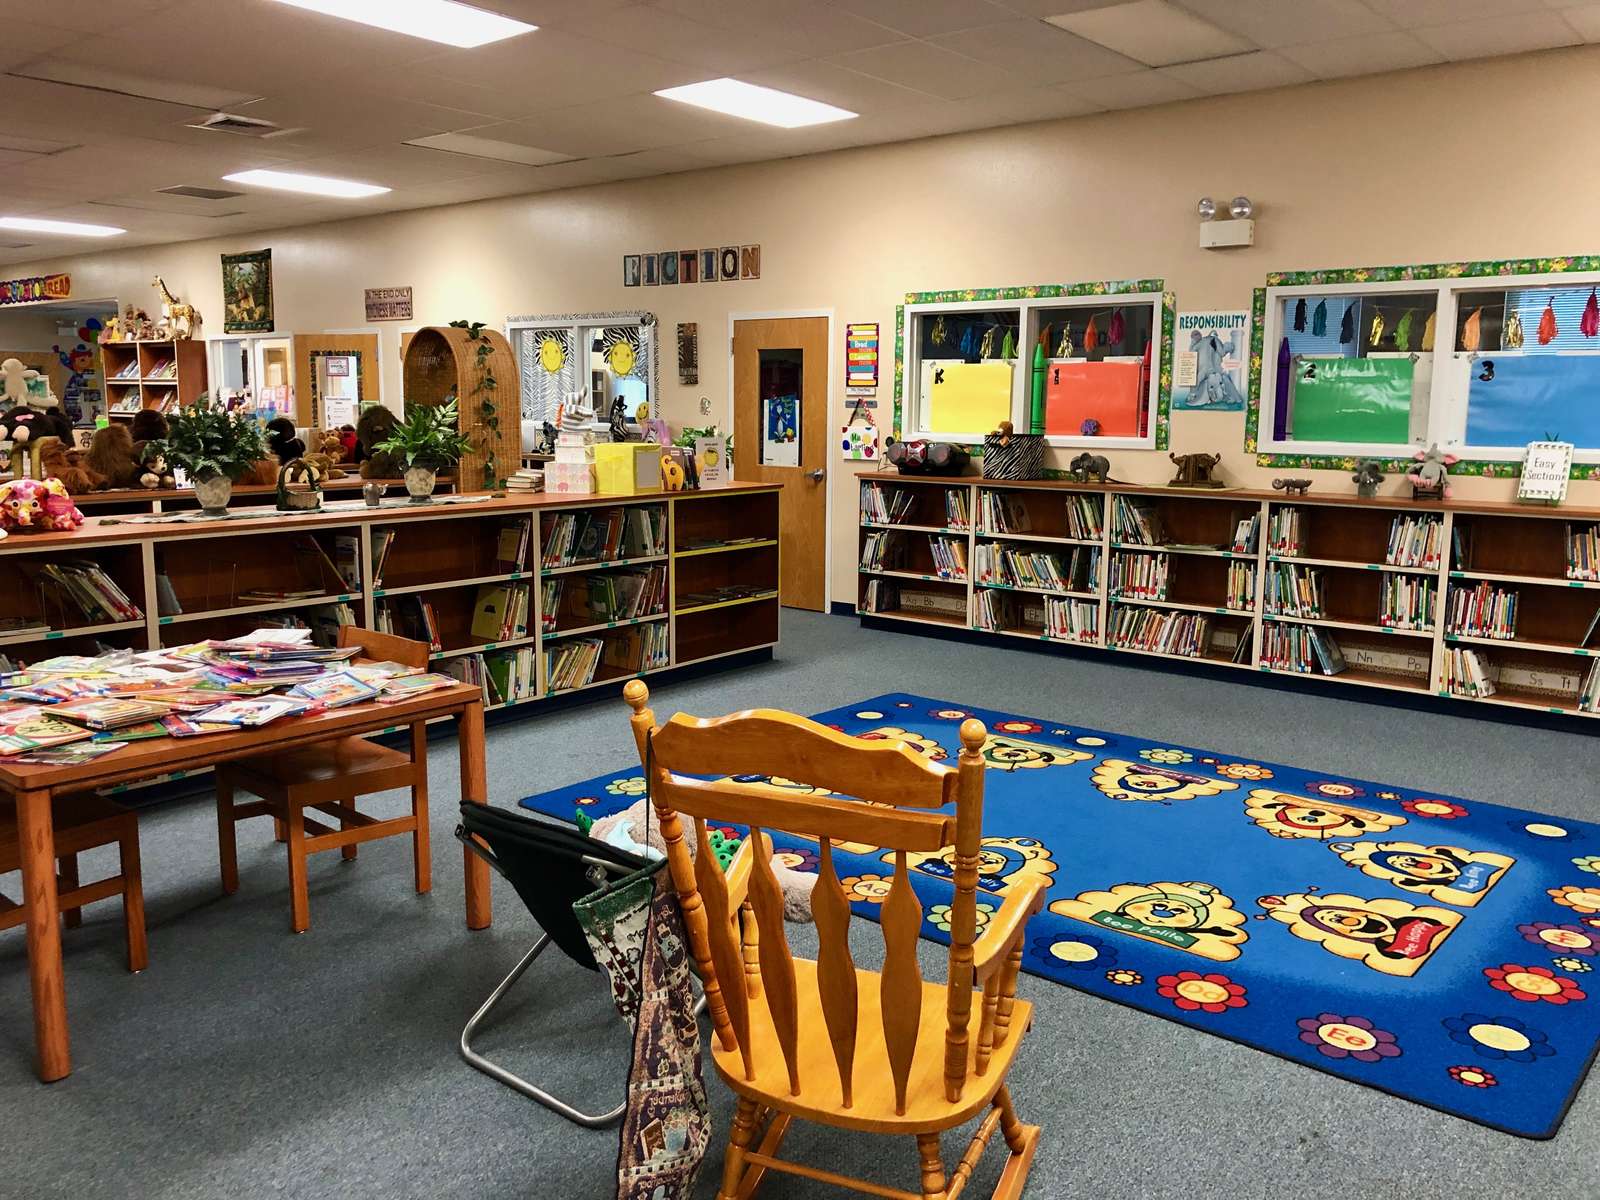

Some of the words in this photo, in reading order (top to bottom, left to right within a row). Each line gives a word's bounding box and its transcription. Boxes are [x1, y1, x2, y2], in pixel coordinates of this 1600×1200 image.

[624, 246, 760, 286] FICTION
[46, 276, 71, 296] READ
[372, 289, 383, 299] THE
[383, 289, 394, 298] END
[394, 288, 410, 298] ONLY
[1179, 314, 1247, 329] RESPONSIBILITY
[934, 368, 945, 385] K
[1303, 364, 1316, 379] 2
[1479, 360, 1495, 381] 3
[1534, 457, 1556, 470] Easy
[1527, 470, 1561, 481] Section
[923, 596, 935, 607] Bb
[1357, 651, 1373, 664] Nn
[1407, 656, 1422, 670] Pp
[1529, 672, 1543, 686] Ss
[1561, 676, 1571, 689] Tt
[923, 863, 946, 874] Bee
[1458, 878, 1479, 889] Bee
[1104, 916, 1134, 929] Bee
[1138, 926, 1185, 942] Polite
[1393, 942, 1418, 955] Bee
[1406, 921, 1433, 942] Happy
[1181, 982, 1225, 1000] Dd
[1326, 1027, 1367, 1047] Ee
